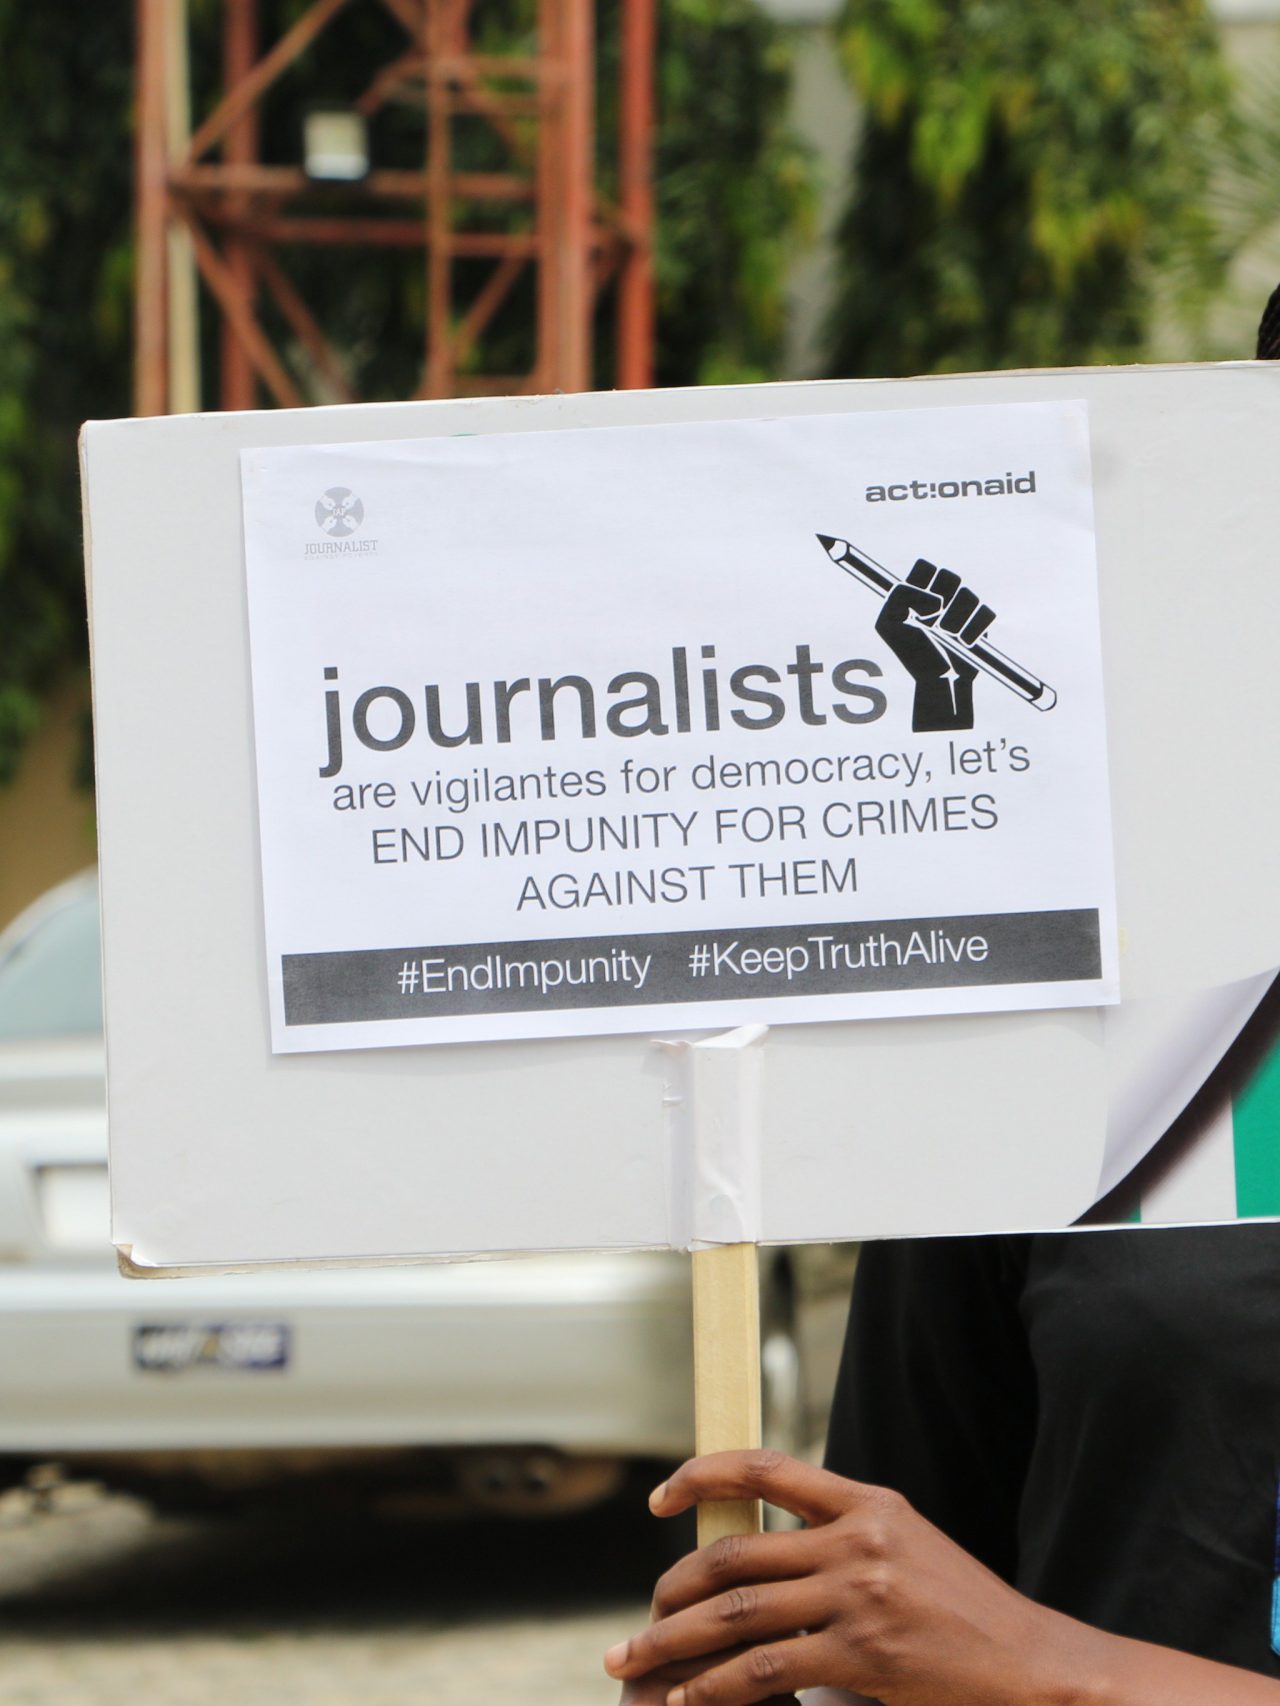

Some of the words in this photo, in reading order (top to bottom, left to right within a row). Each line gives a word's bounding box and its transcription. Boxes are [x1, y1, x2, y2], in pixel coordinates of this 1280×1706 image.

[304, 540, 378, 555] JOURNALIST
[319, 644, 888, 778] journalists
[333, 781, 396, 811] are
[411, 766, 606, 814] vigilantes
[620, 759, 677, 794] for
[691, 752, 932, 790] democracy,
[372, 825, 464, 864] END
[481, 811, 698, 858] IMPUNITY
[715, 805, 808, 844] FOR
[822, 793, 999, 838] CRIMES
[516, 865, 715, 911] AGAINST
[728, 857, 858, 899] THEM
[397, 948, 652, 995] #EndImpunity
[688, 930, 989, 981] #KeepTruthAlive
